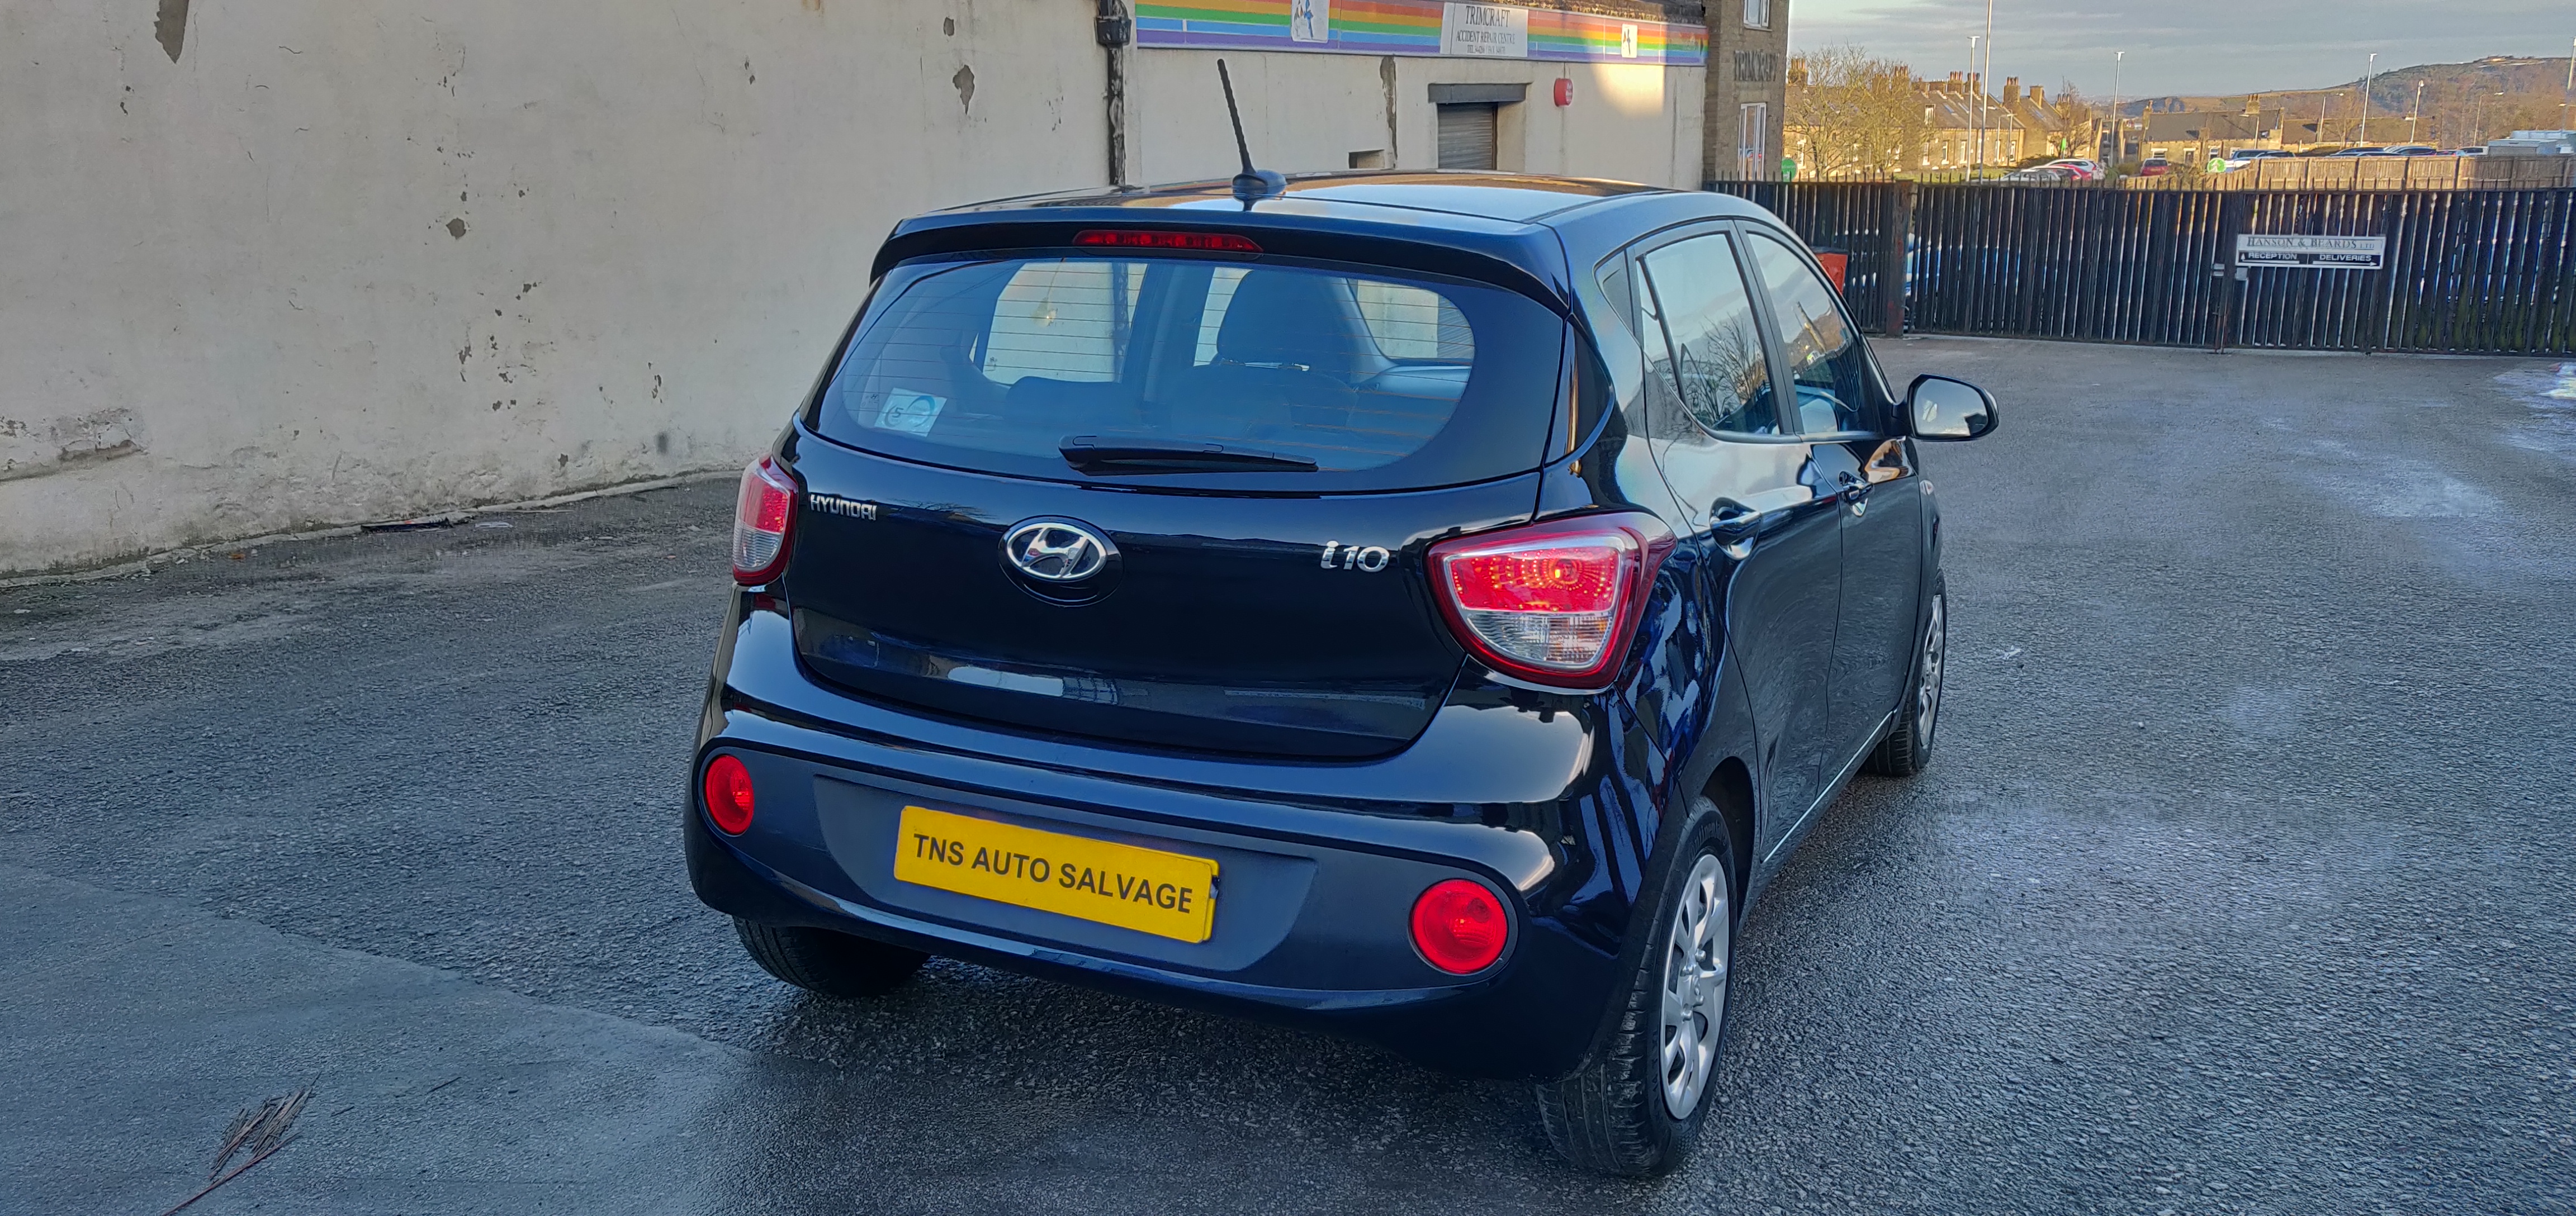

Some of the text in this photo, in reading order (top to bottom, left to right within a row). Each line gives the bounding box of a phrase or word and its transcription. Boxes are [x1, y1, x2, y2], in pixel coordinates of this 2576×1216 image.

[1466, 6, 1510, 27] TRIMCRAFT
[1456, 30, 1480, 42] ACCIDENT
[1498, 33, 1515, 44] CENTRE
[2247, 237, 2293, 247] HANSON
[2298, 238, 2306, 247] &
[2310, 239, 2356, 249] BEARDS
[2248, 251, 2298, 260] RECEPTION
[811, 494, 877, 521] HYUNDAI
[1320, 540, 1390, 572] i10
[913, 833, 1193, 914] TNS AUTO SALVAGE
